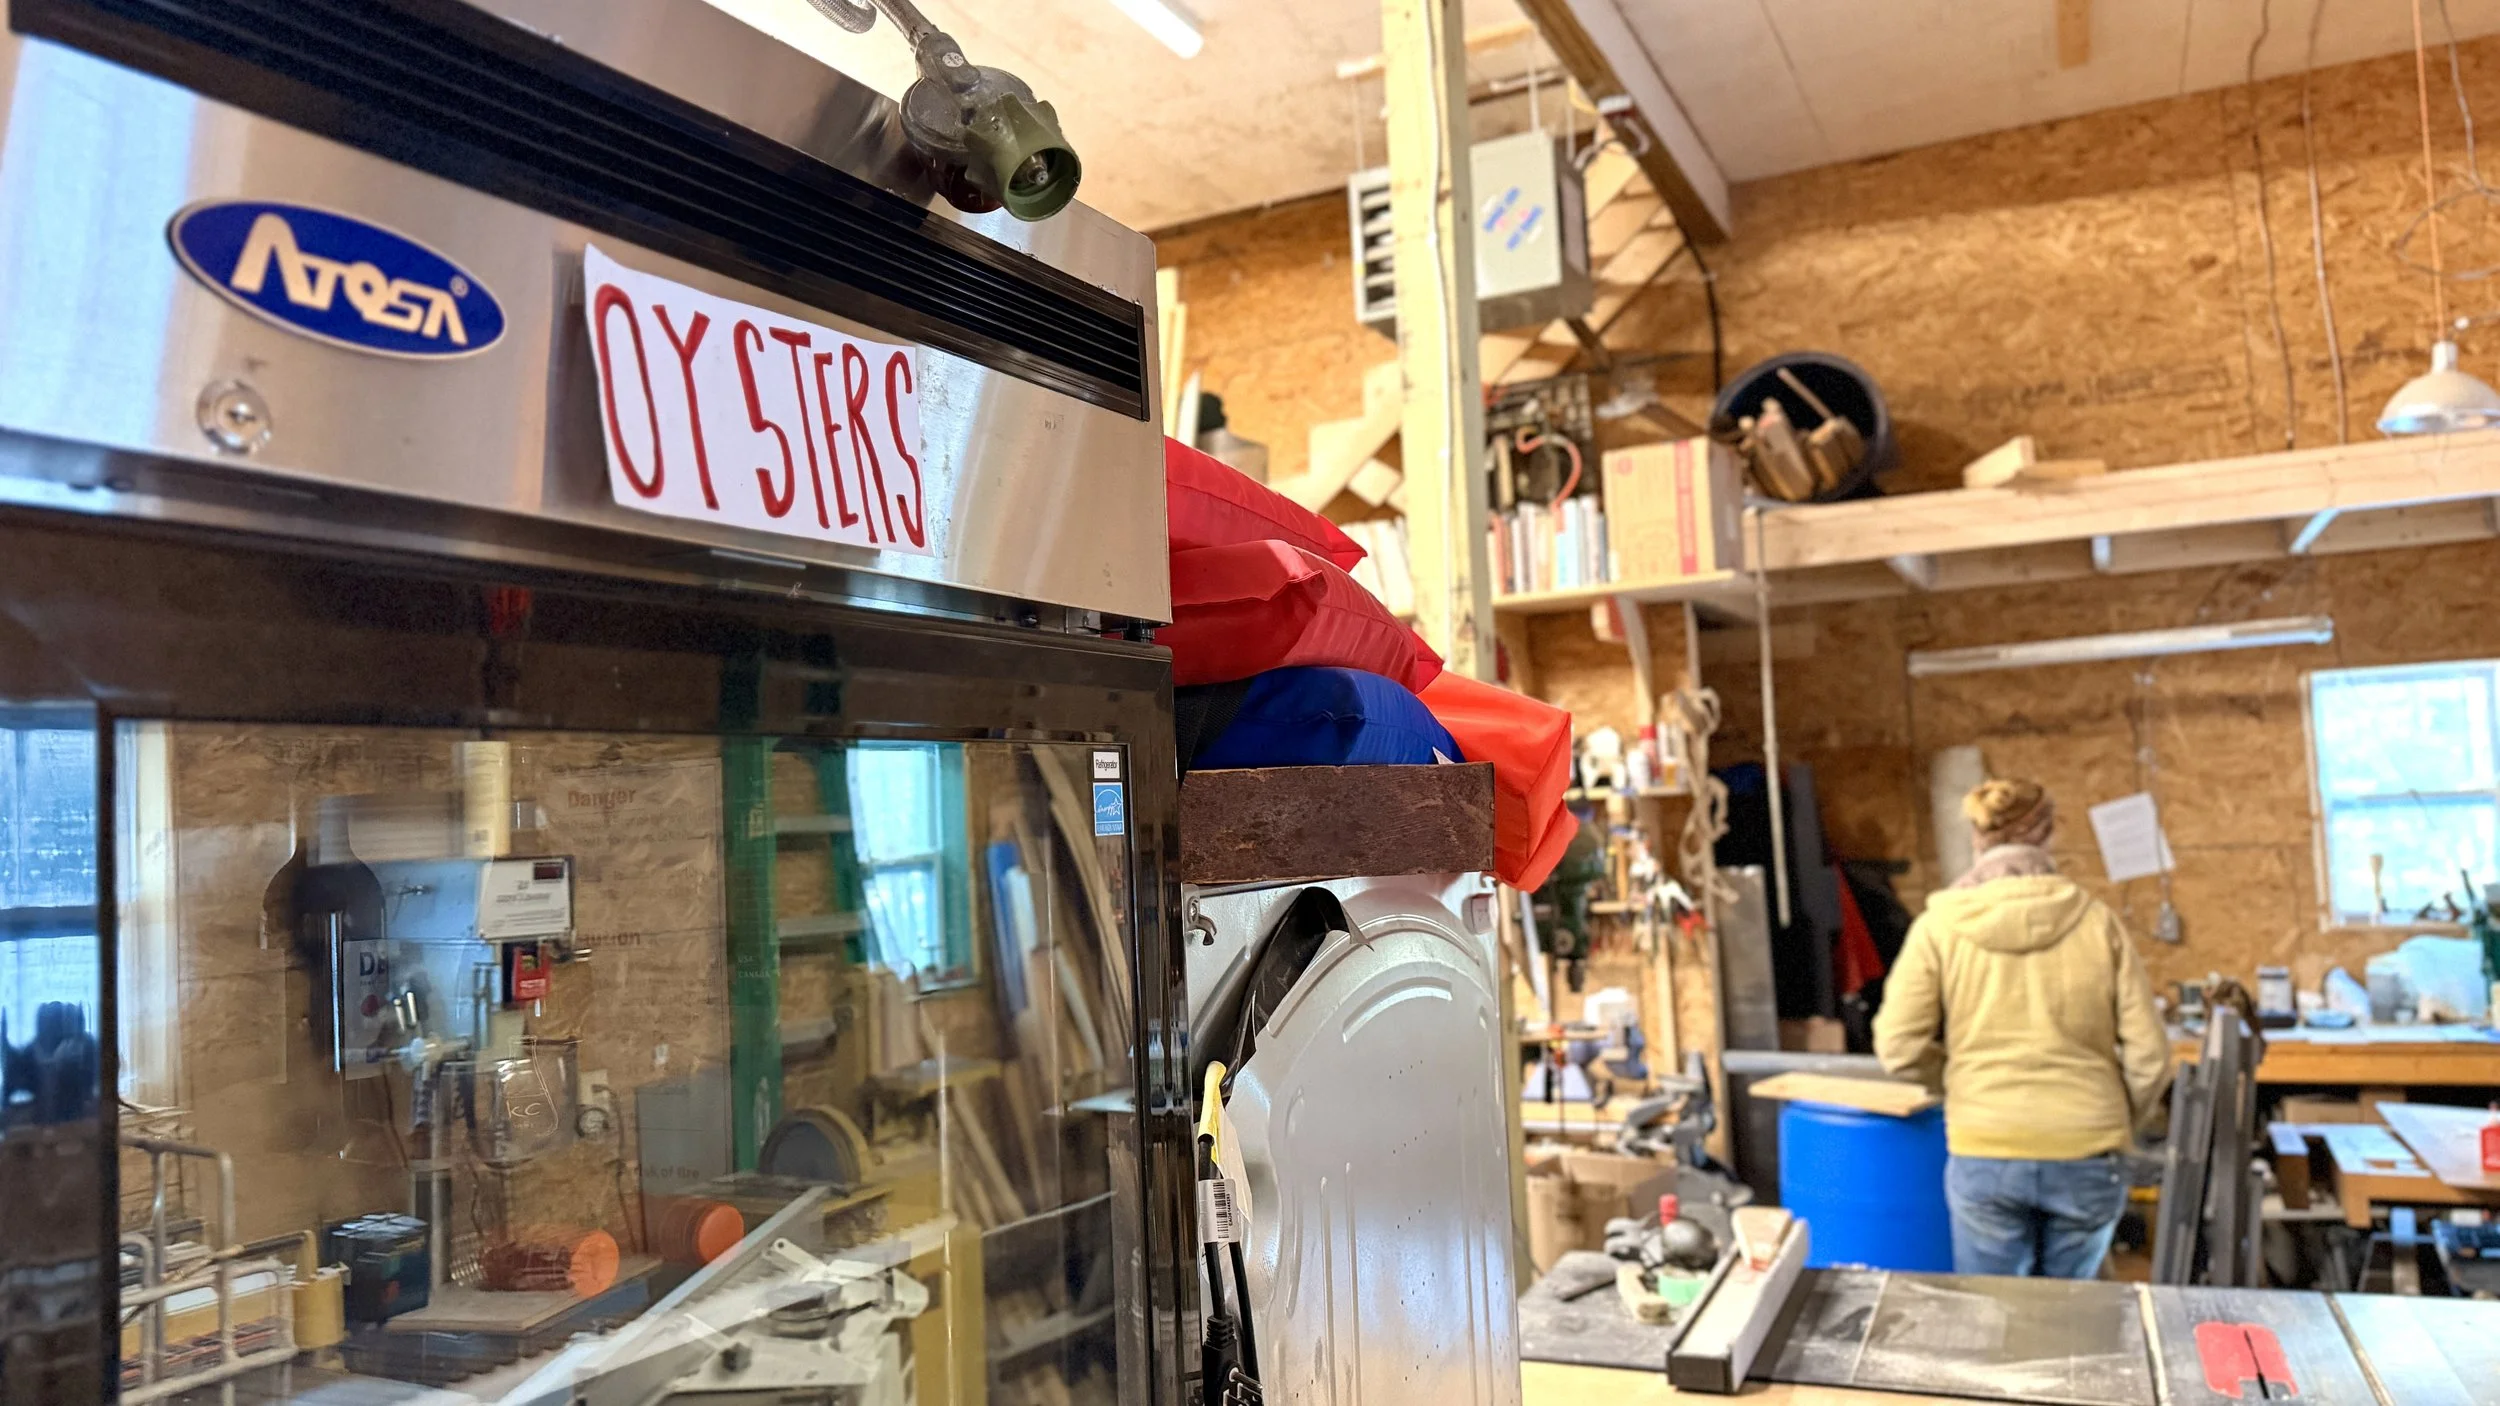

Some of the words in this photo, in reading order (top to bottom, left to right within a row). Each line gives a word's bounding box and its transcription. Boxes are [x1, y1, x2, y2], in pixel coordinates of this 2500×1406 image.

[593, 282, 925, 548] OYSTERS
[1095, 759, 1118, 771] Refrigerator
[567, 787, 637, 810] Danger
